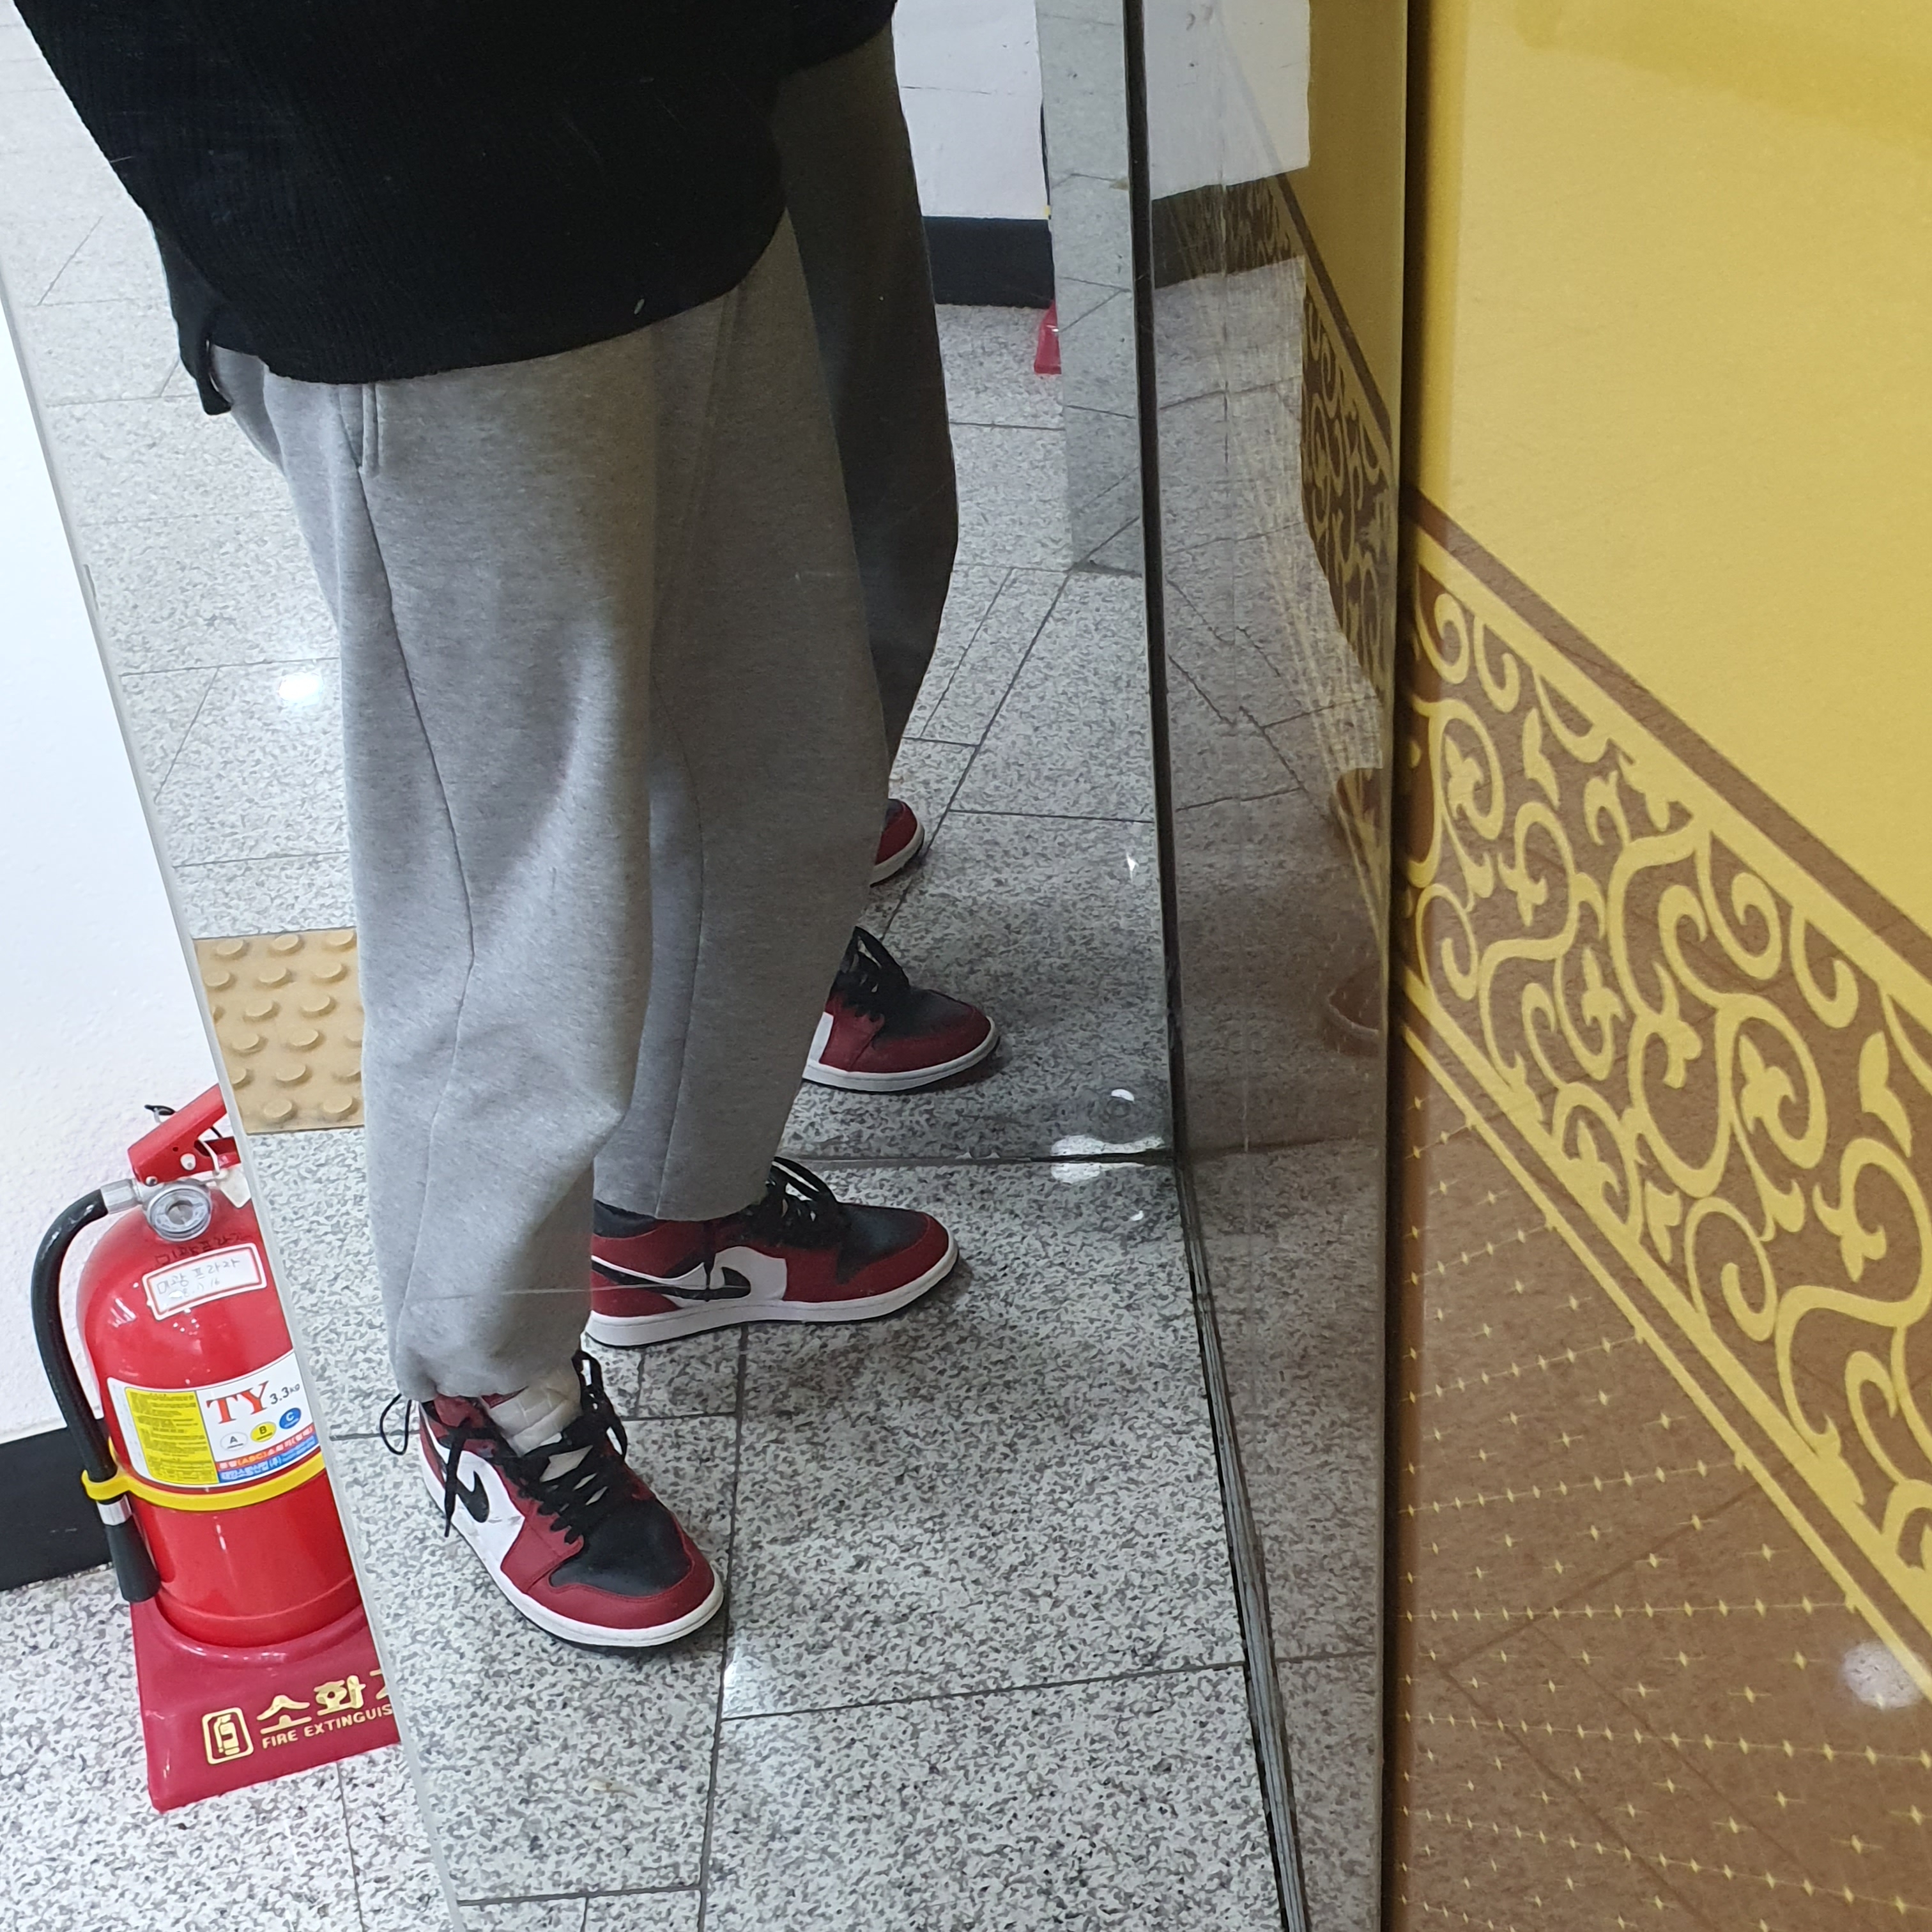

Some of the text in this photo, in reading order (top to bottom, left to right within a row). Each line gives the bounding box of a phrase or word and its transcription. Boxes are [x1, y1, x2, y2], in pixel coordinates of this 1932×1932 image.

[206, 1380, 269, 1425] TY
[262, 1703, 394, 1749] FIRE EXTINGUIS
